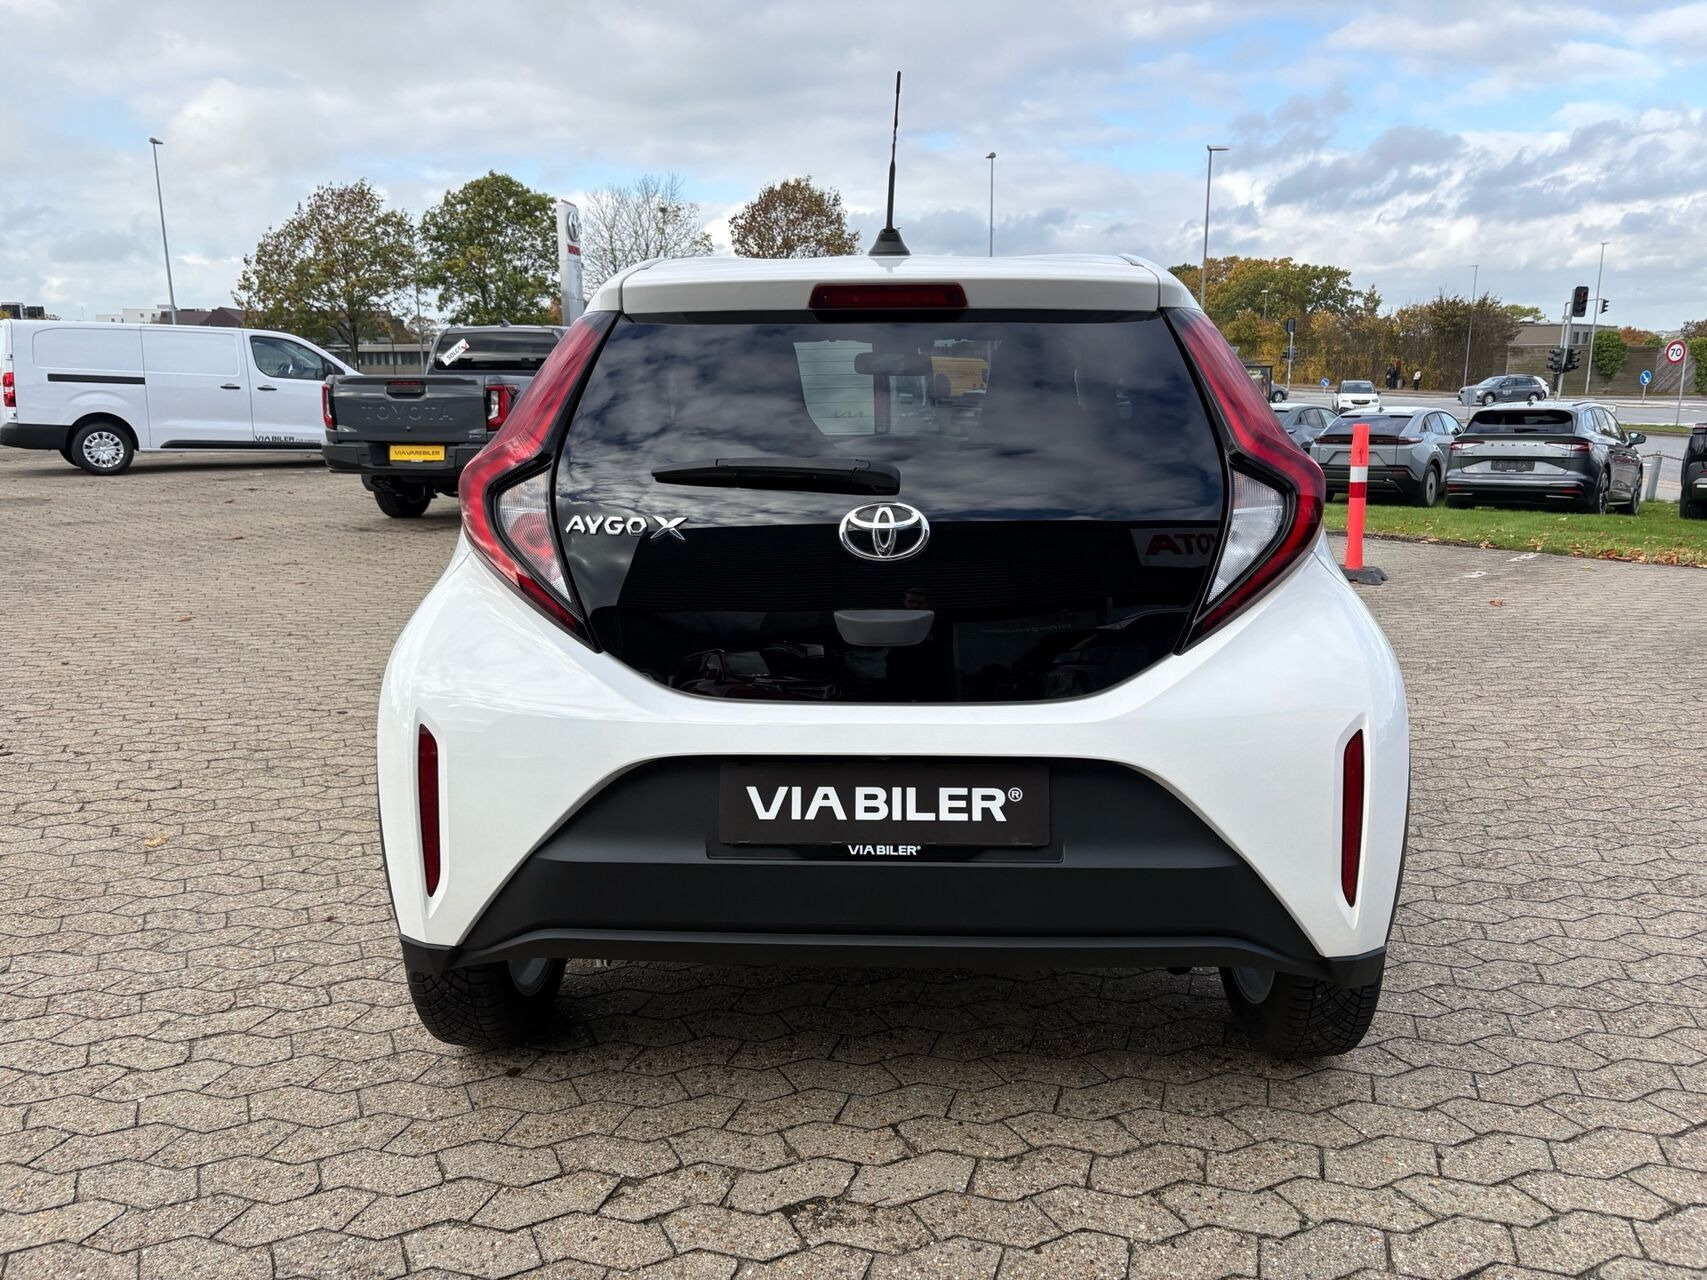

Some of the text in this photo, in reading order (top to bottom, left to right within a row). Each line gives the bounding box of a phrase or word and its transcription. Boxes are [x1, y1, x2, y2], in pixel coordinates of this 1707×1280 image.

[1670, 348, 1682, 357] 70
[360, 405, 454, 421] TOYOTA
[565, 515, 688, 541] AYGO X
